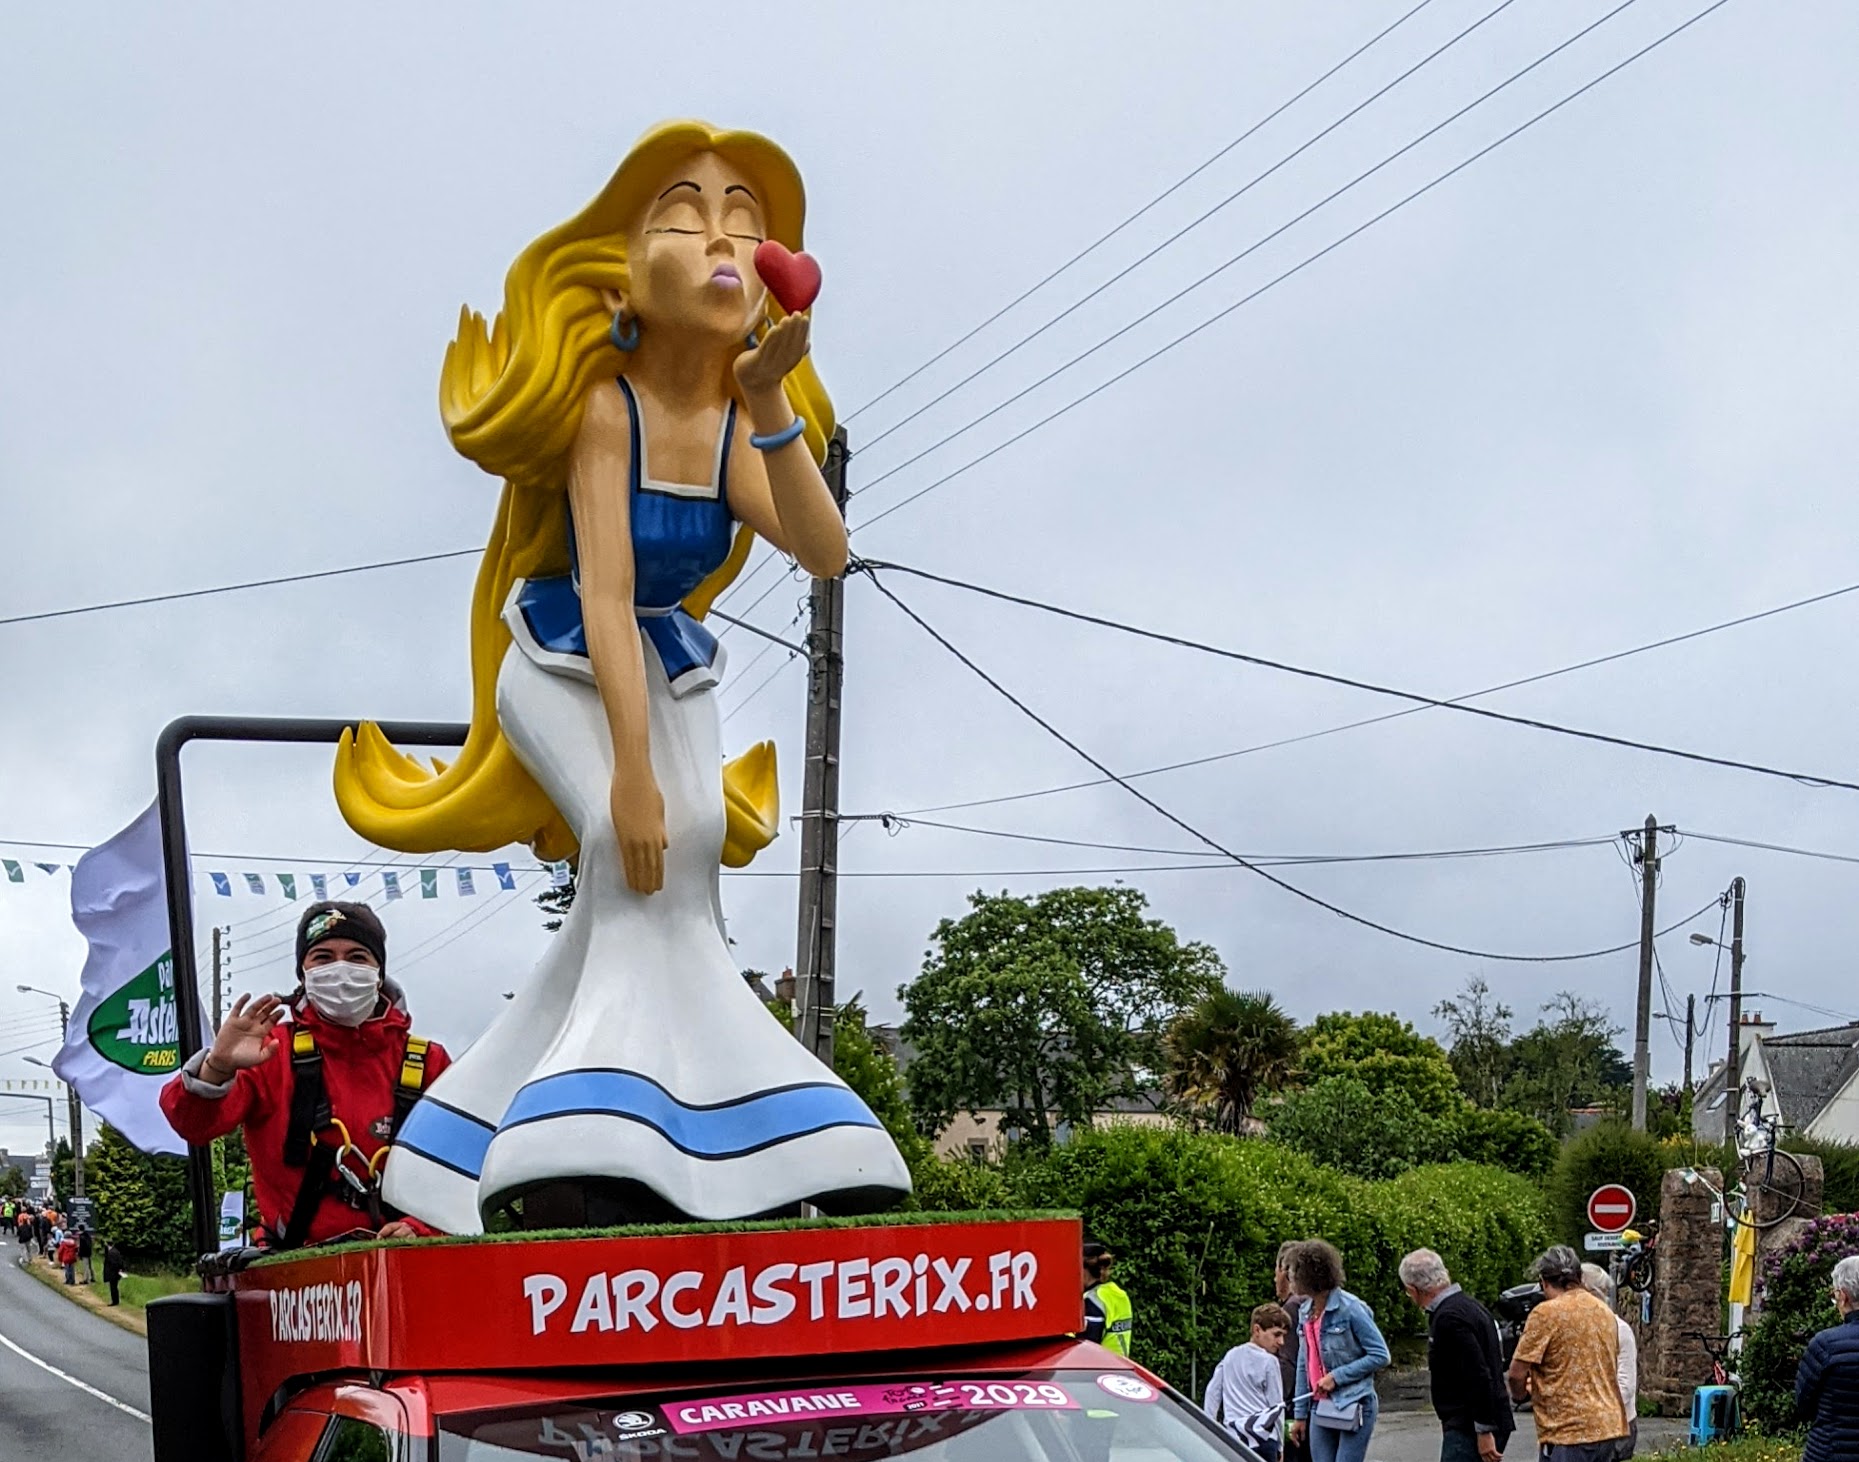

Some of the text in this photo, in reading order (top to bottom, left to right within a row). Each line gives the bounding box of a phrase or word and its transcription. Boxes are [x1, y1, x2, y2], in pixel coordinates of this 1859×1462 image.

[143, 1049, 177, 1066] PARIS
[270, 1279, 362, 1344] PARCASTERiX.FR
[523, 1250, 1038, 1335] PARCASTERiX.FR
[679, 1384, 1069, 1424] CARAVANE 2029
